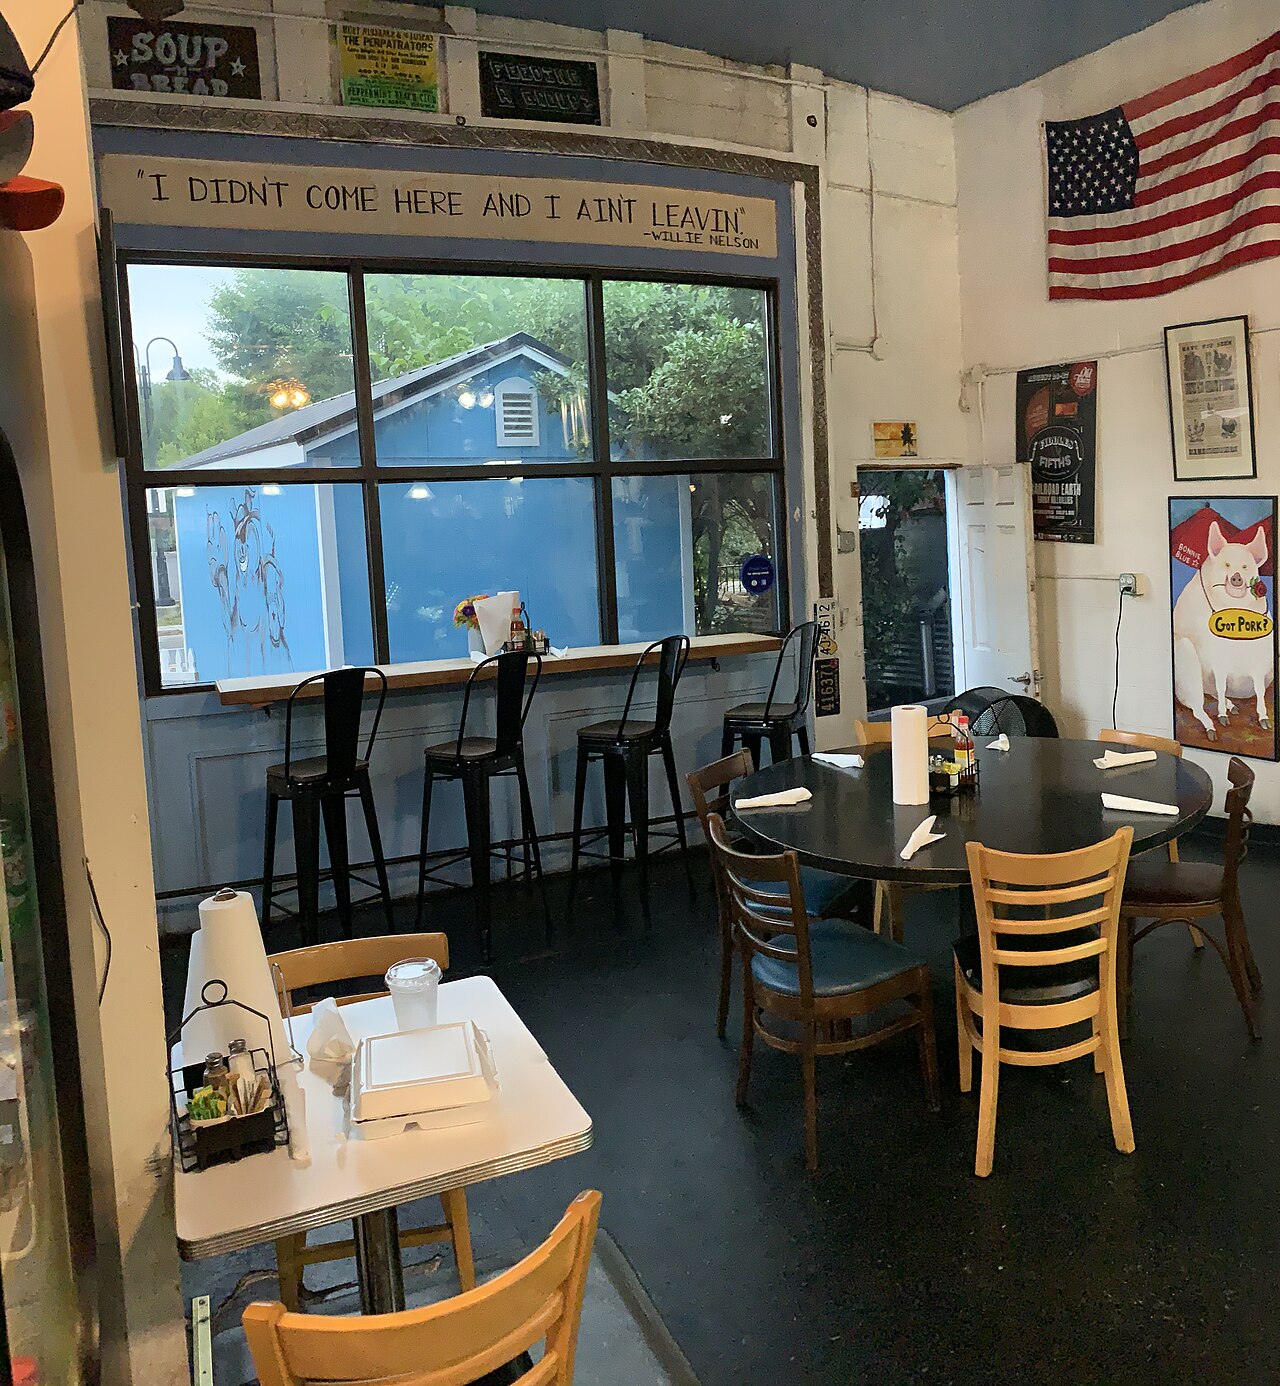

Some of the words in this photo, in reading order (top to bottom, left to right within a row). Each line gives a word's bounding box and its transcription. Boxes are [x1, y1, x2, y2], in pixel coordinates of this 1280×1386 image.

[343, 35, 360, 46] THE
[130, 31, 229, 68] SOUP
[188, 176, 288, 207] DIDN'T
[306, 184, 377, 211] COME
[395, 188, 463, 216] HERE
[482, 192, 531, 218] AND
[545, 195, 561, 219] I
[577, 193, 637, 223] AIN'T
[709, 234, 759, 249] NELSON
[1040, 454, 1072, 469] FIFTHS
[1175, 550, 1191, 564] BLUE
[1178, 543, 1201, 559] BONNIE
